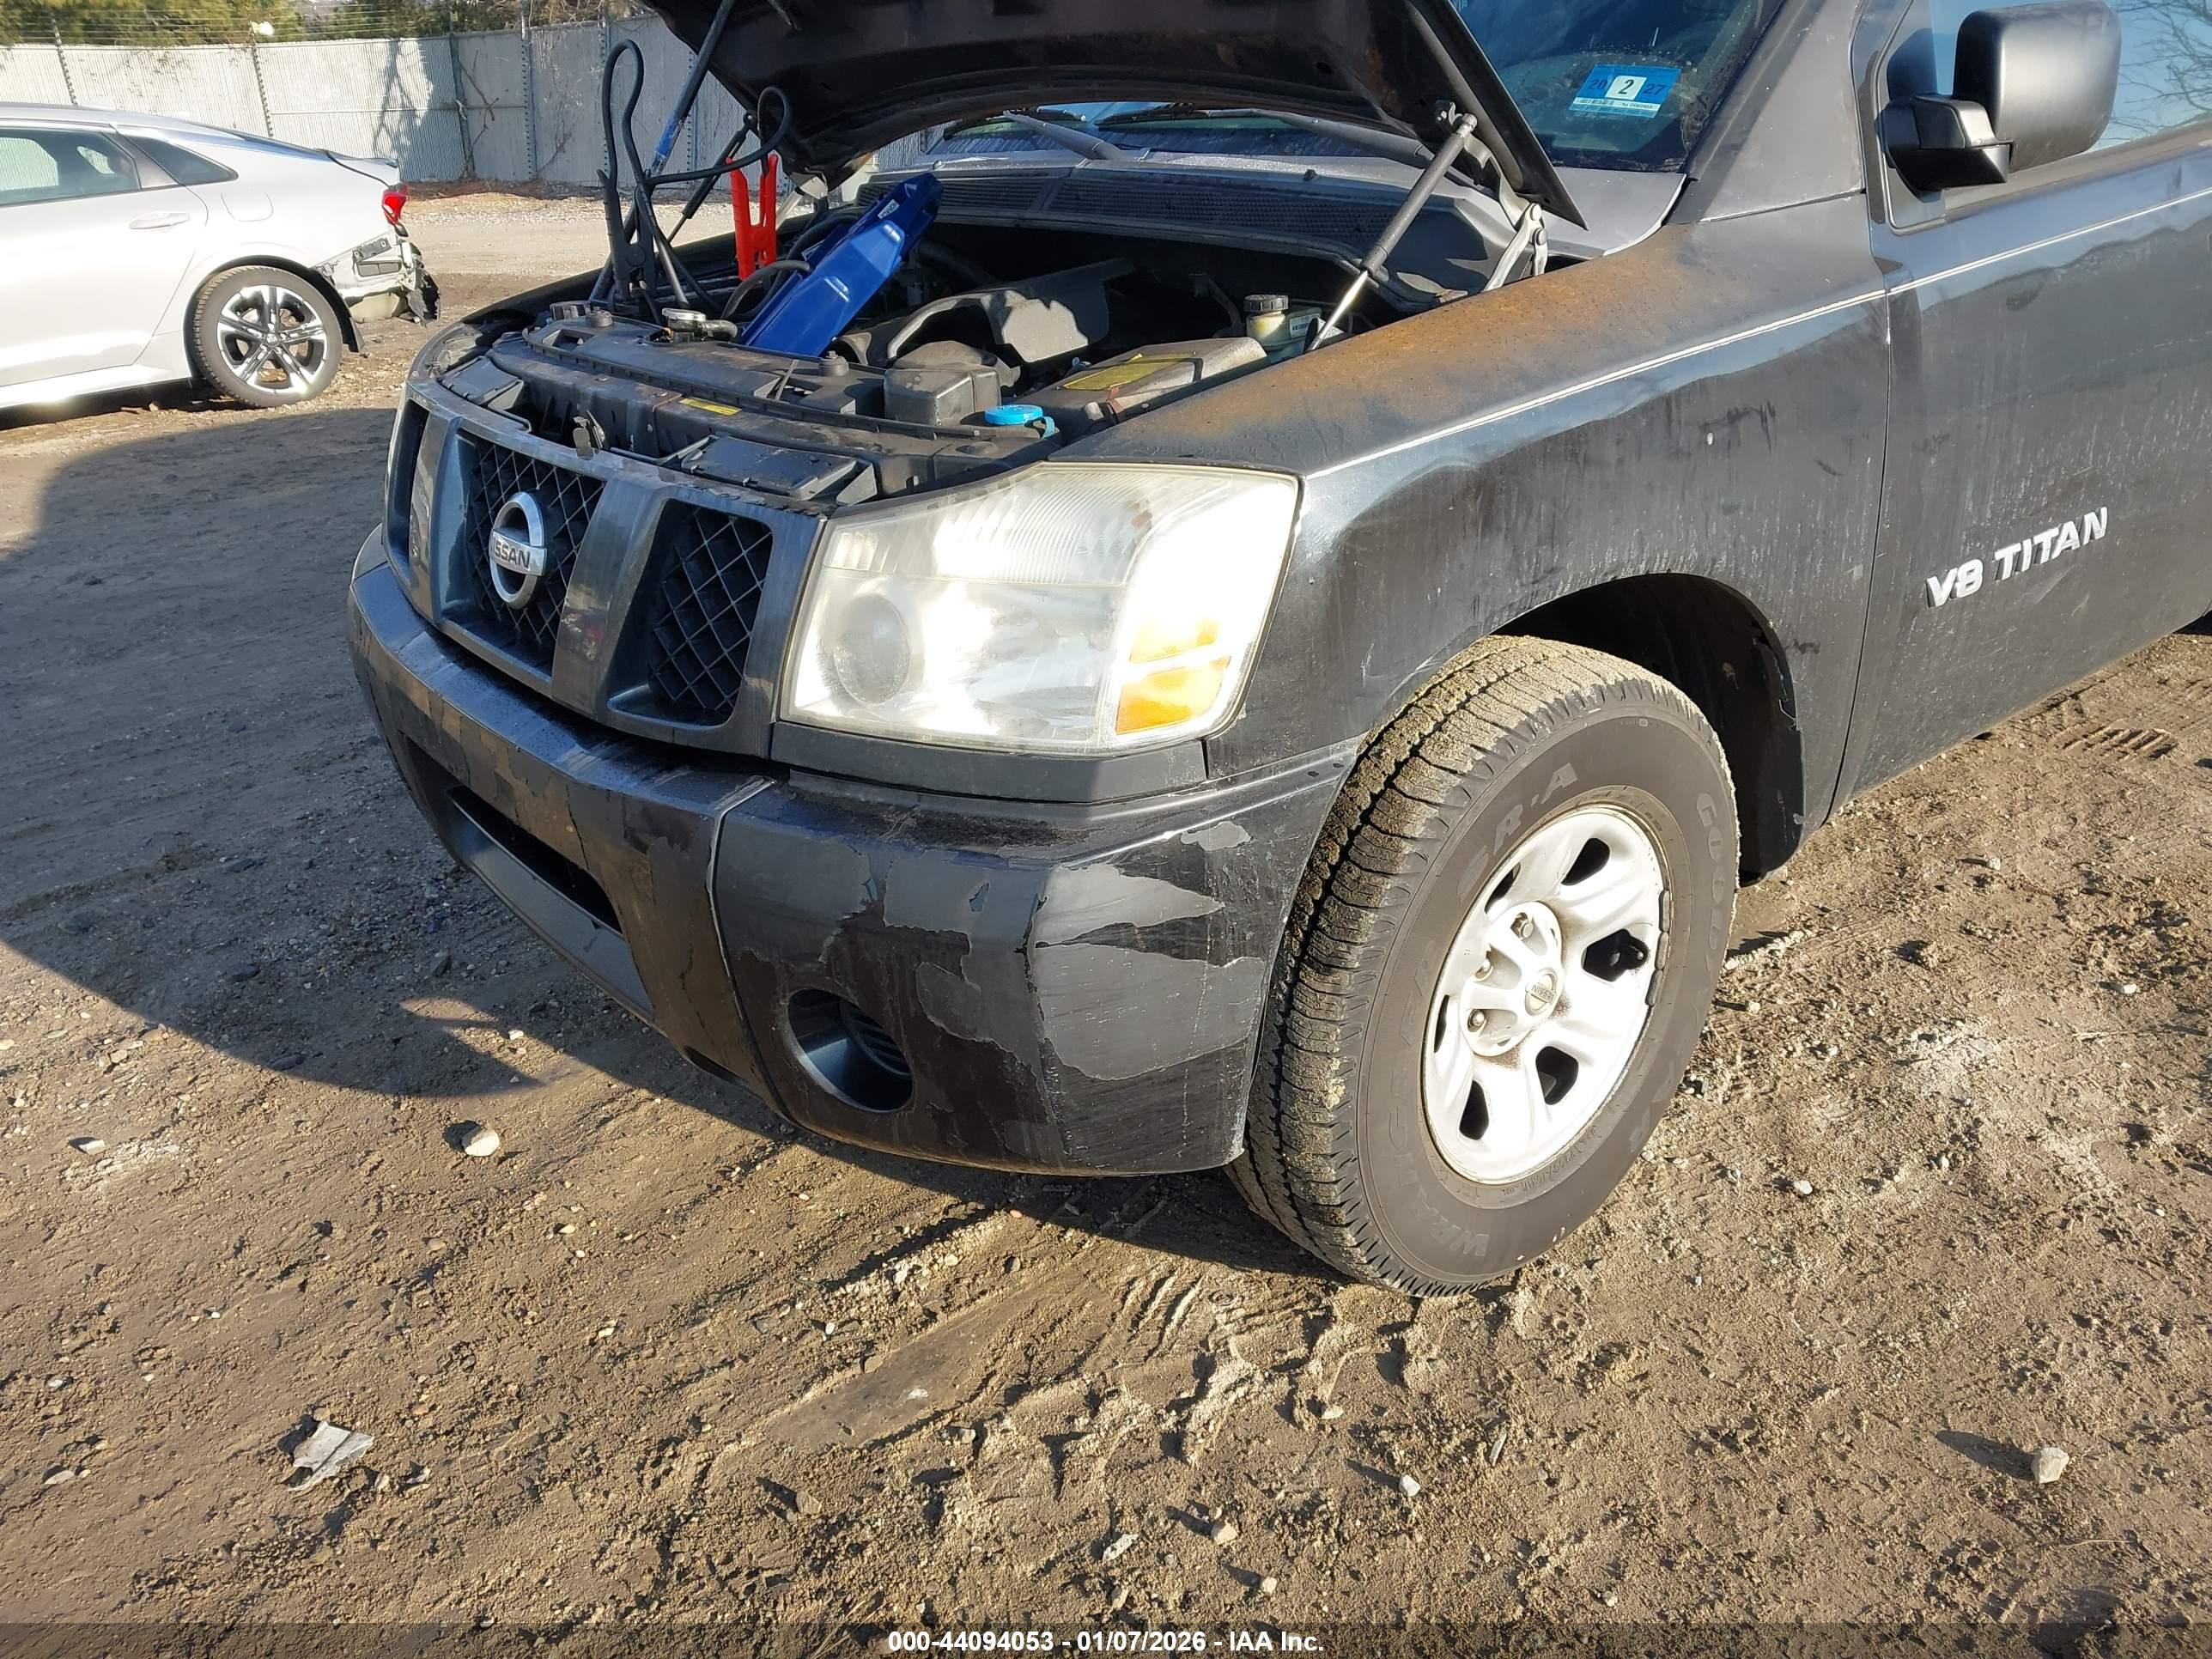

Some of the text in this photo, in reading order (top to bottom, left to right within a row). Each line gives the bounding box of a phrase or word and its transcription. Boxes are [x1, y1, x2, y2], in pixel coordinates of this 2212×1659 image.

[1588, 79, 1667, 94] 20 2 27
[494, 538, 531, 568] SSAN
[1925, 506, 2108, 608] V8 TITAN
